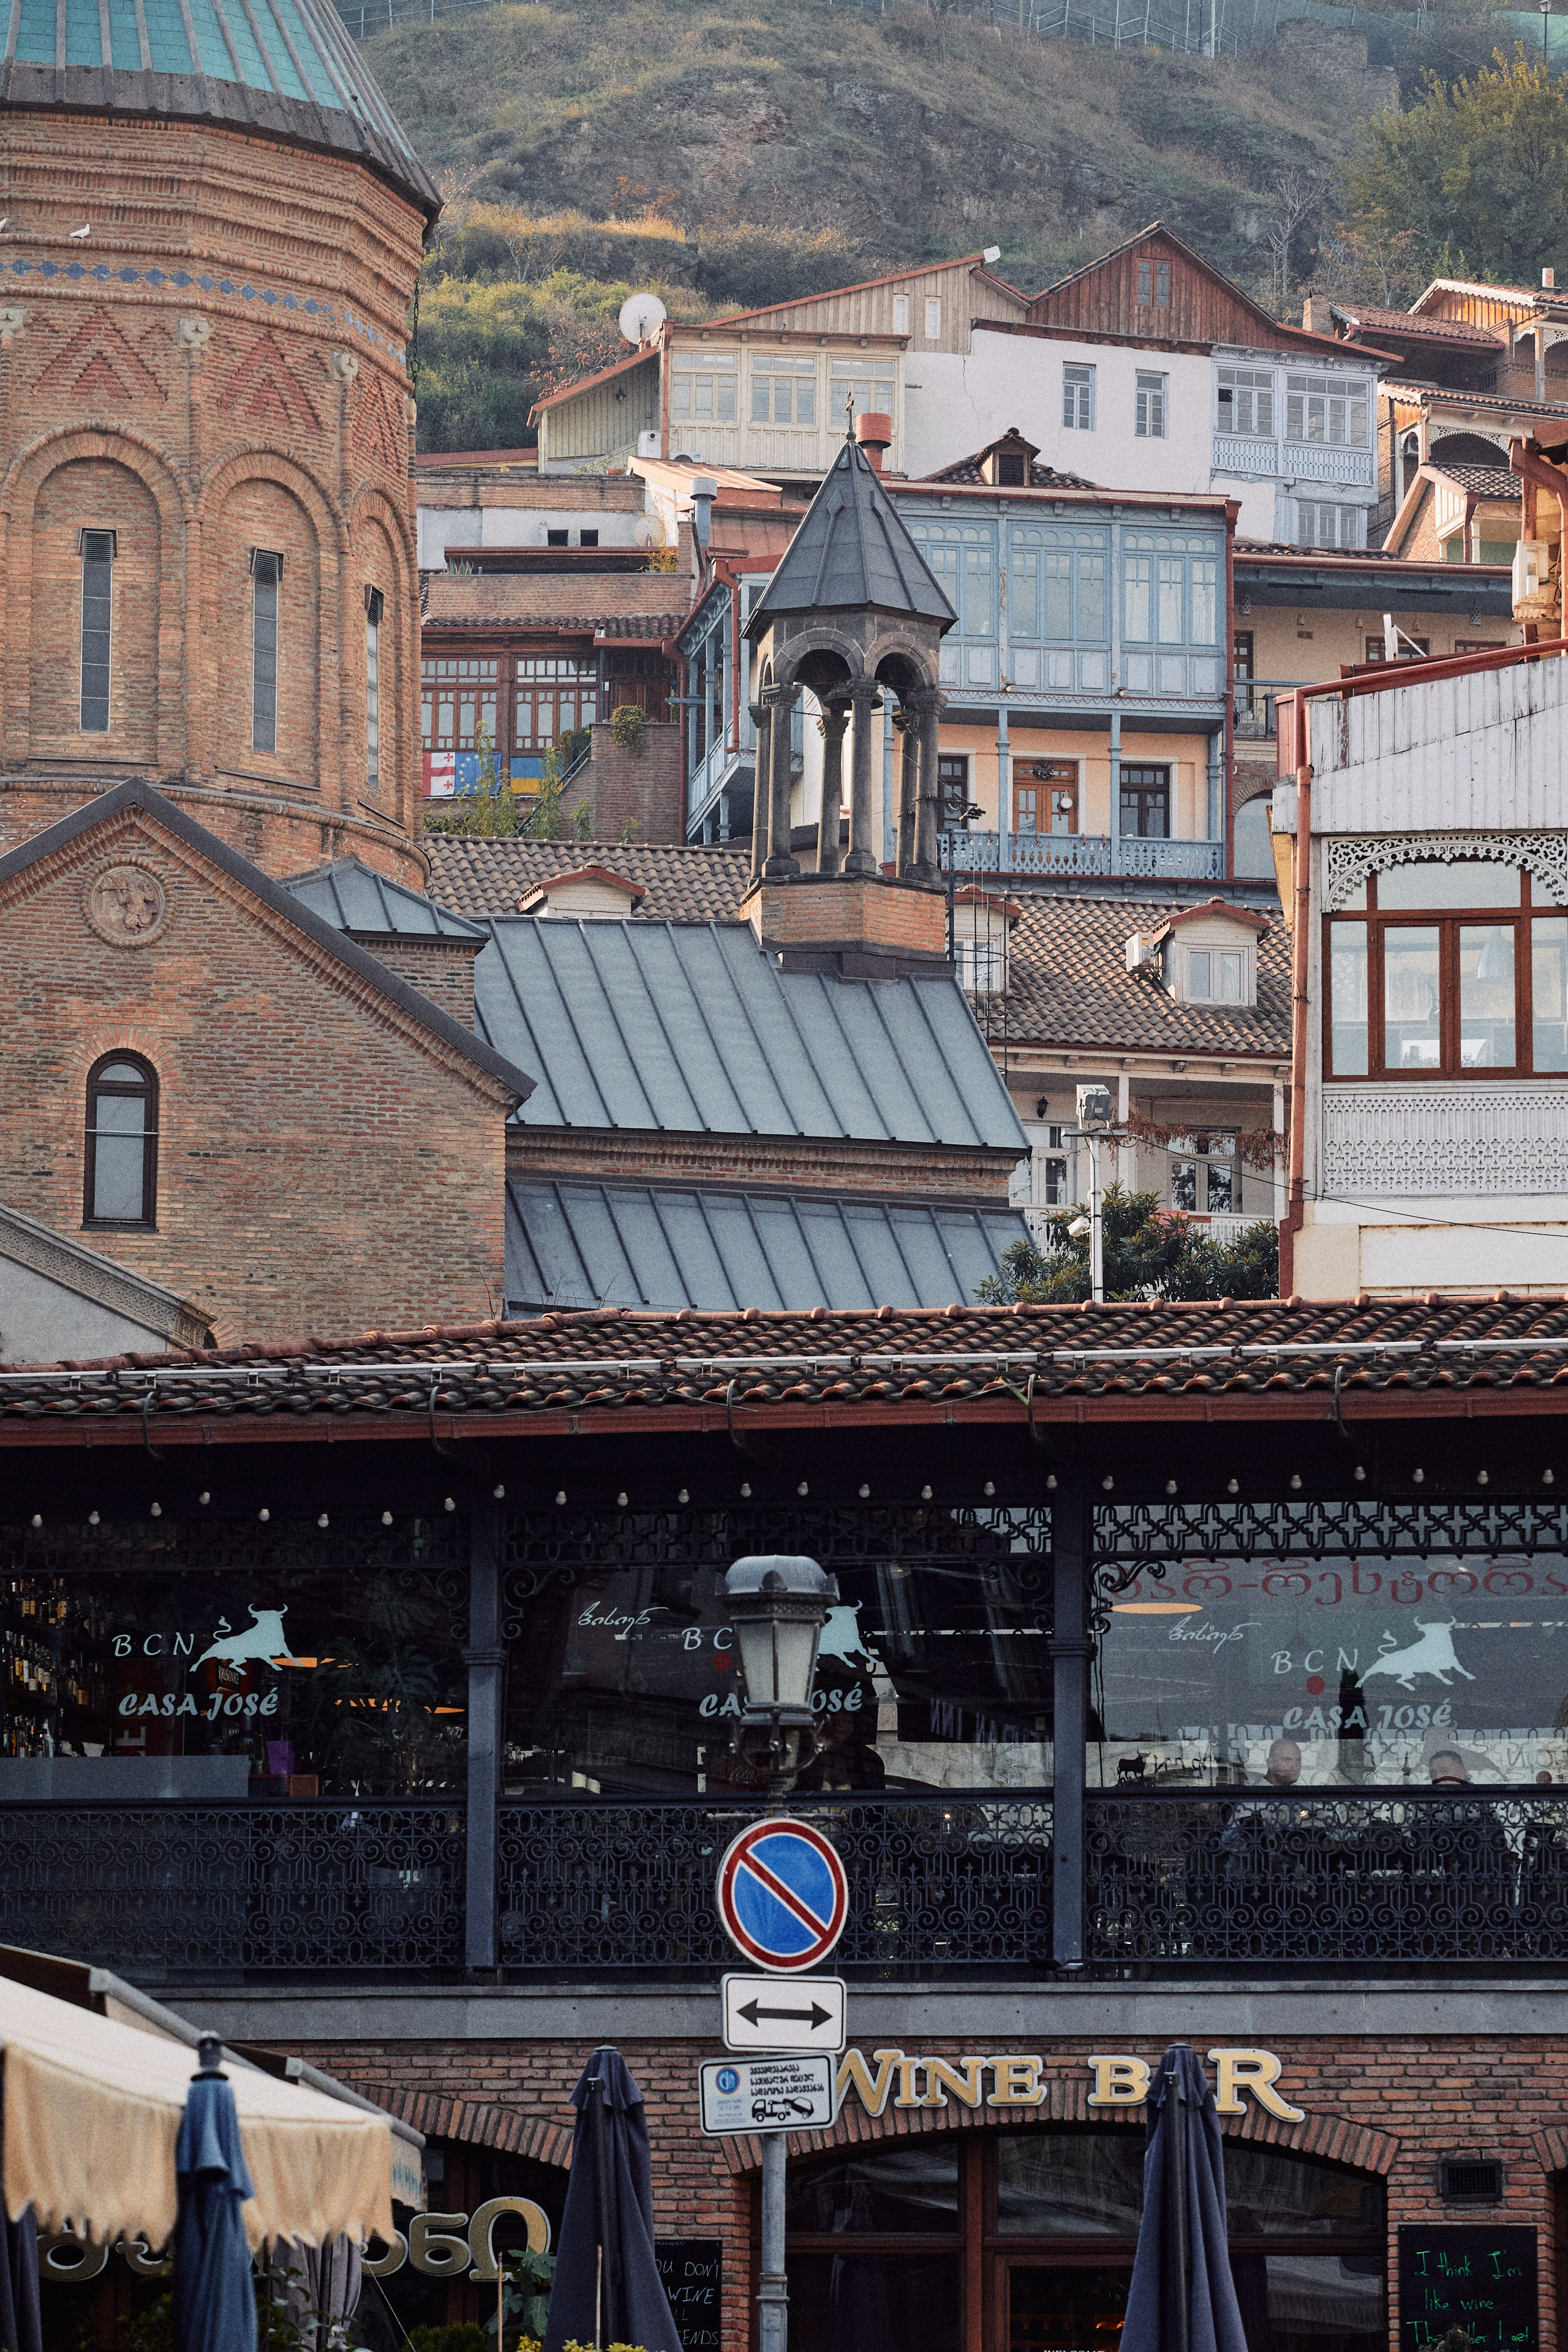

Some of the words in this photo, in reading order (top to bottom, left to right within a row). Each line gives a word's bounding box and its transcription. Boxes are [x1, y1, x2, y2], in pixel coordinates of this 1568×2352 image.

[112, 1632, 195, 1657] BCN
[682, 1627, 733, 1649] BC
[1271, 1647, 1359, 1674] BCN
[118, 1693, 198, 1716] CASA
[206, 1687, 278, 1721] JOSÉ
[699, 1693, 749, 1717] CA
[810, 1681, 863, 1713] OSÉ
[1283, 1705, 1367, 1730] CASA
[1376, 1697, 1453, 1730] JOSÉ
[837, 2048, 1048, 2118] WINE
[1087, 2048, 1306, 2123] BR
[684, 2259, 721, 2279] DON'T
[1414, 2251, 1430, 2276] I
[1437, 2252, 1473, 2277] think
[668, 2286, 715, 2304] WINE
[1425, 2288, 1451, 2311] like
